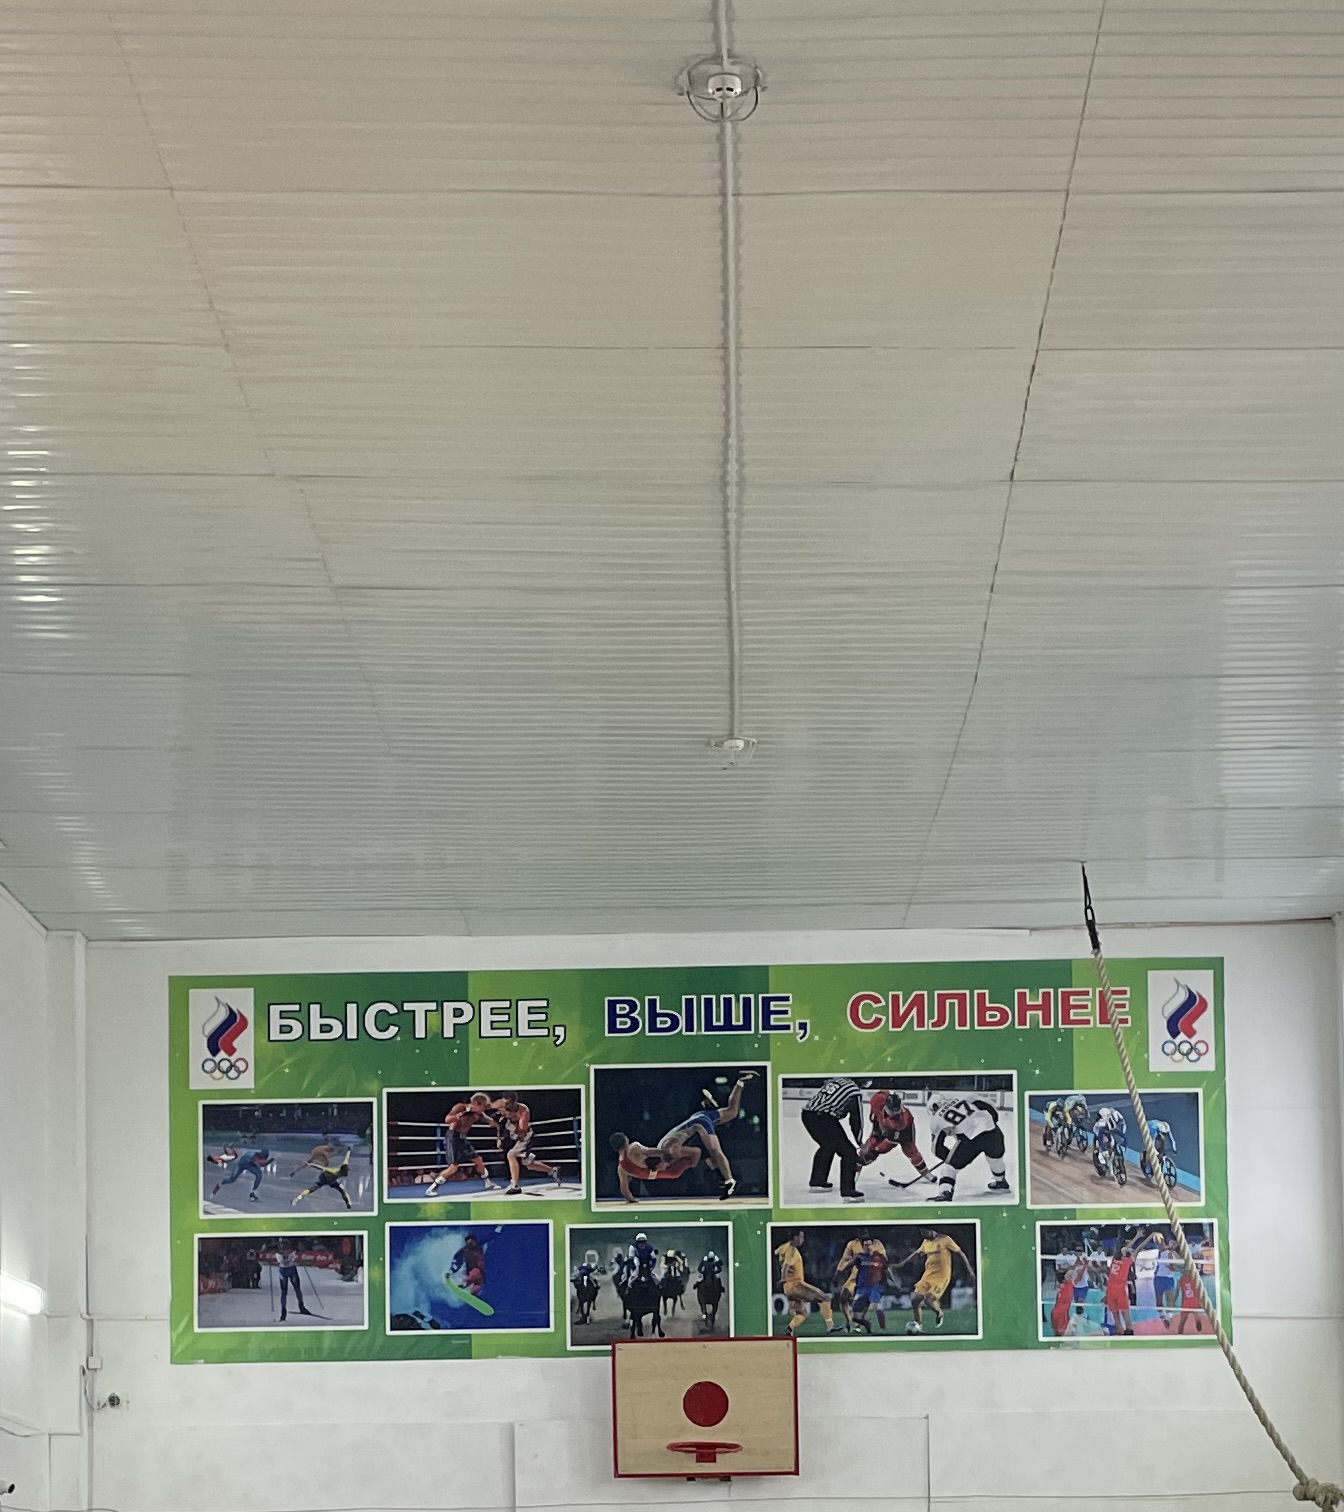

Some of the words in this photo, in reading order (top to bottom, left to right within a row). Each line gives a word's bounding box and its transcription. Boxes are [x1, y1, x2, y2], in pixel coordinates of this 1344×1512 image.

[267, 997, 567, 1047] БЫСТРЕЕ,
[604, 992, 811, 1042] ВЫШЕ,
[847, 987, 1133, 1032] СИЛЬНЕЕ
